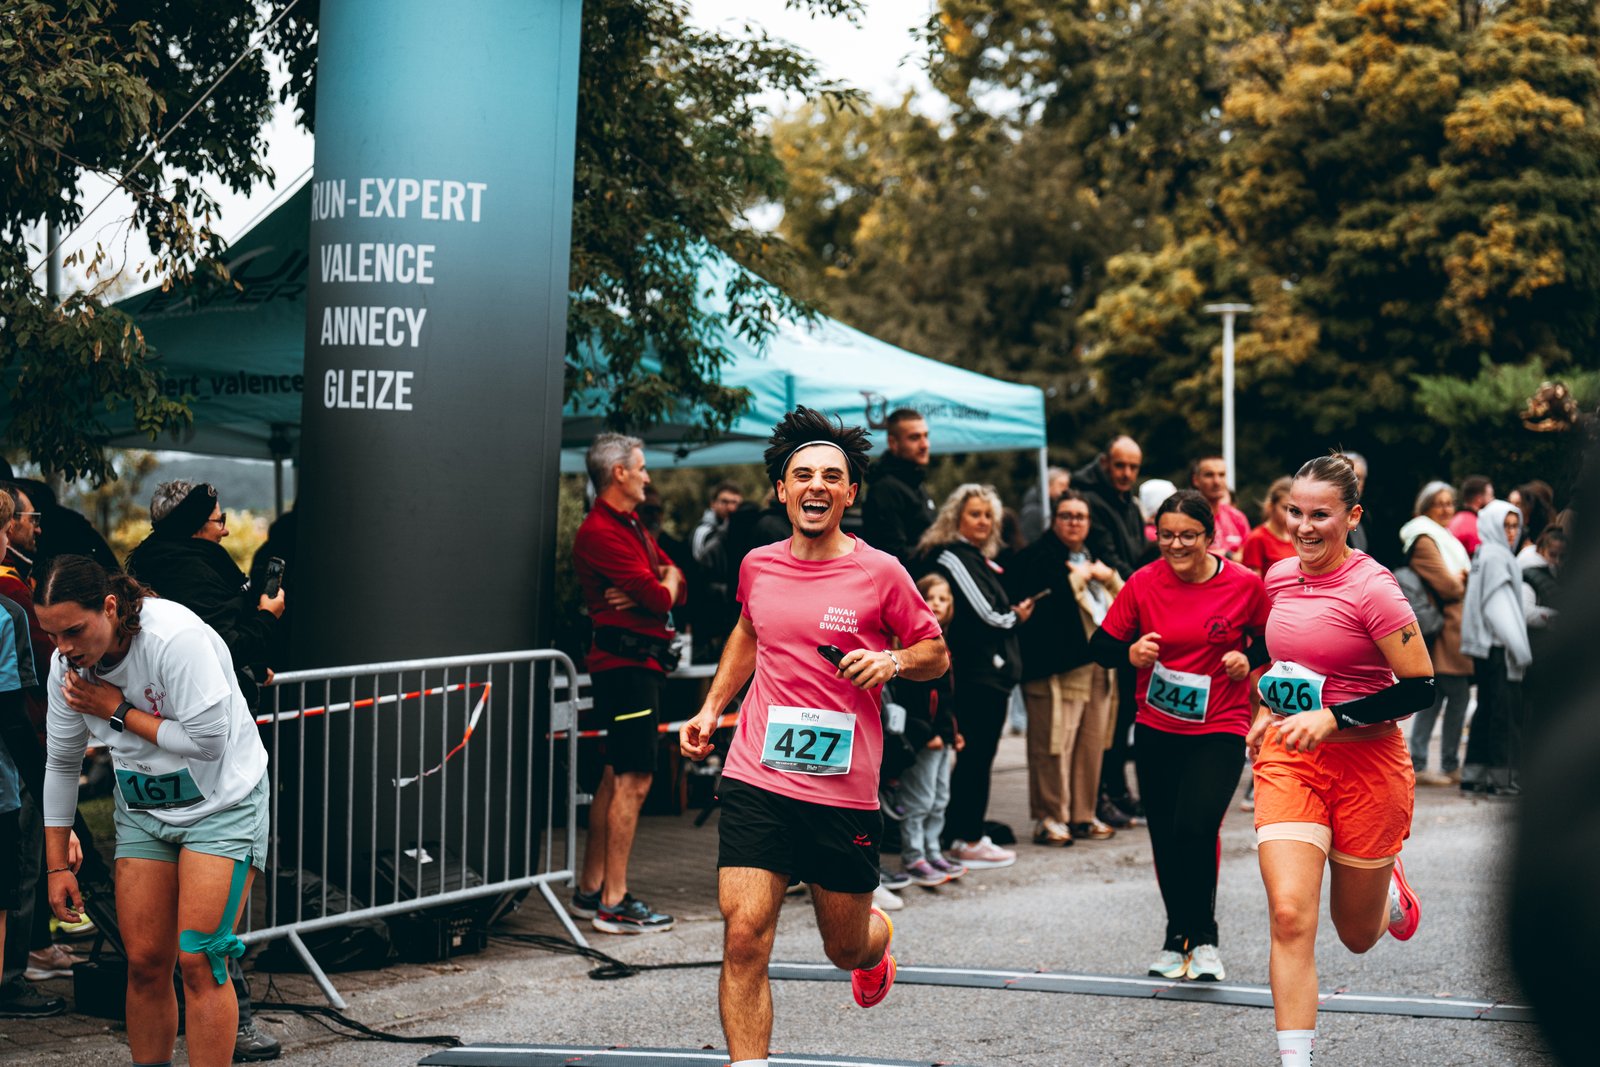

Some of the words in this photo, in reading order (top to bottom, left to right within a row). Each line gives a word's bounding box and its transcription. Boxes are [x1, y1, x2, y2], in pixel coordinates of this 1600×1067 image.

[312, 178, 487, 222] RUN-EXPERT
[321, 243, 436, 285] VALENCE
[320, 306, 427, 348] ANNECY
[323, 369, 414, 411] GLEIZE
[823, 614, 858, 626] BWAAH
[828, 606, 856, 617] BWAH
[819, 621, 859, 634] BWAAAH
[1153, 679, 1198, 711] 244
[1267, 680, 1313, 711] 426
[801, 711, 820, 720] RUN
[774, 728, 841, 762] 427
[126, 774, 181, 801] 167
